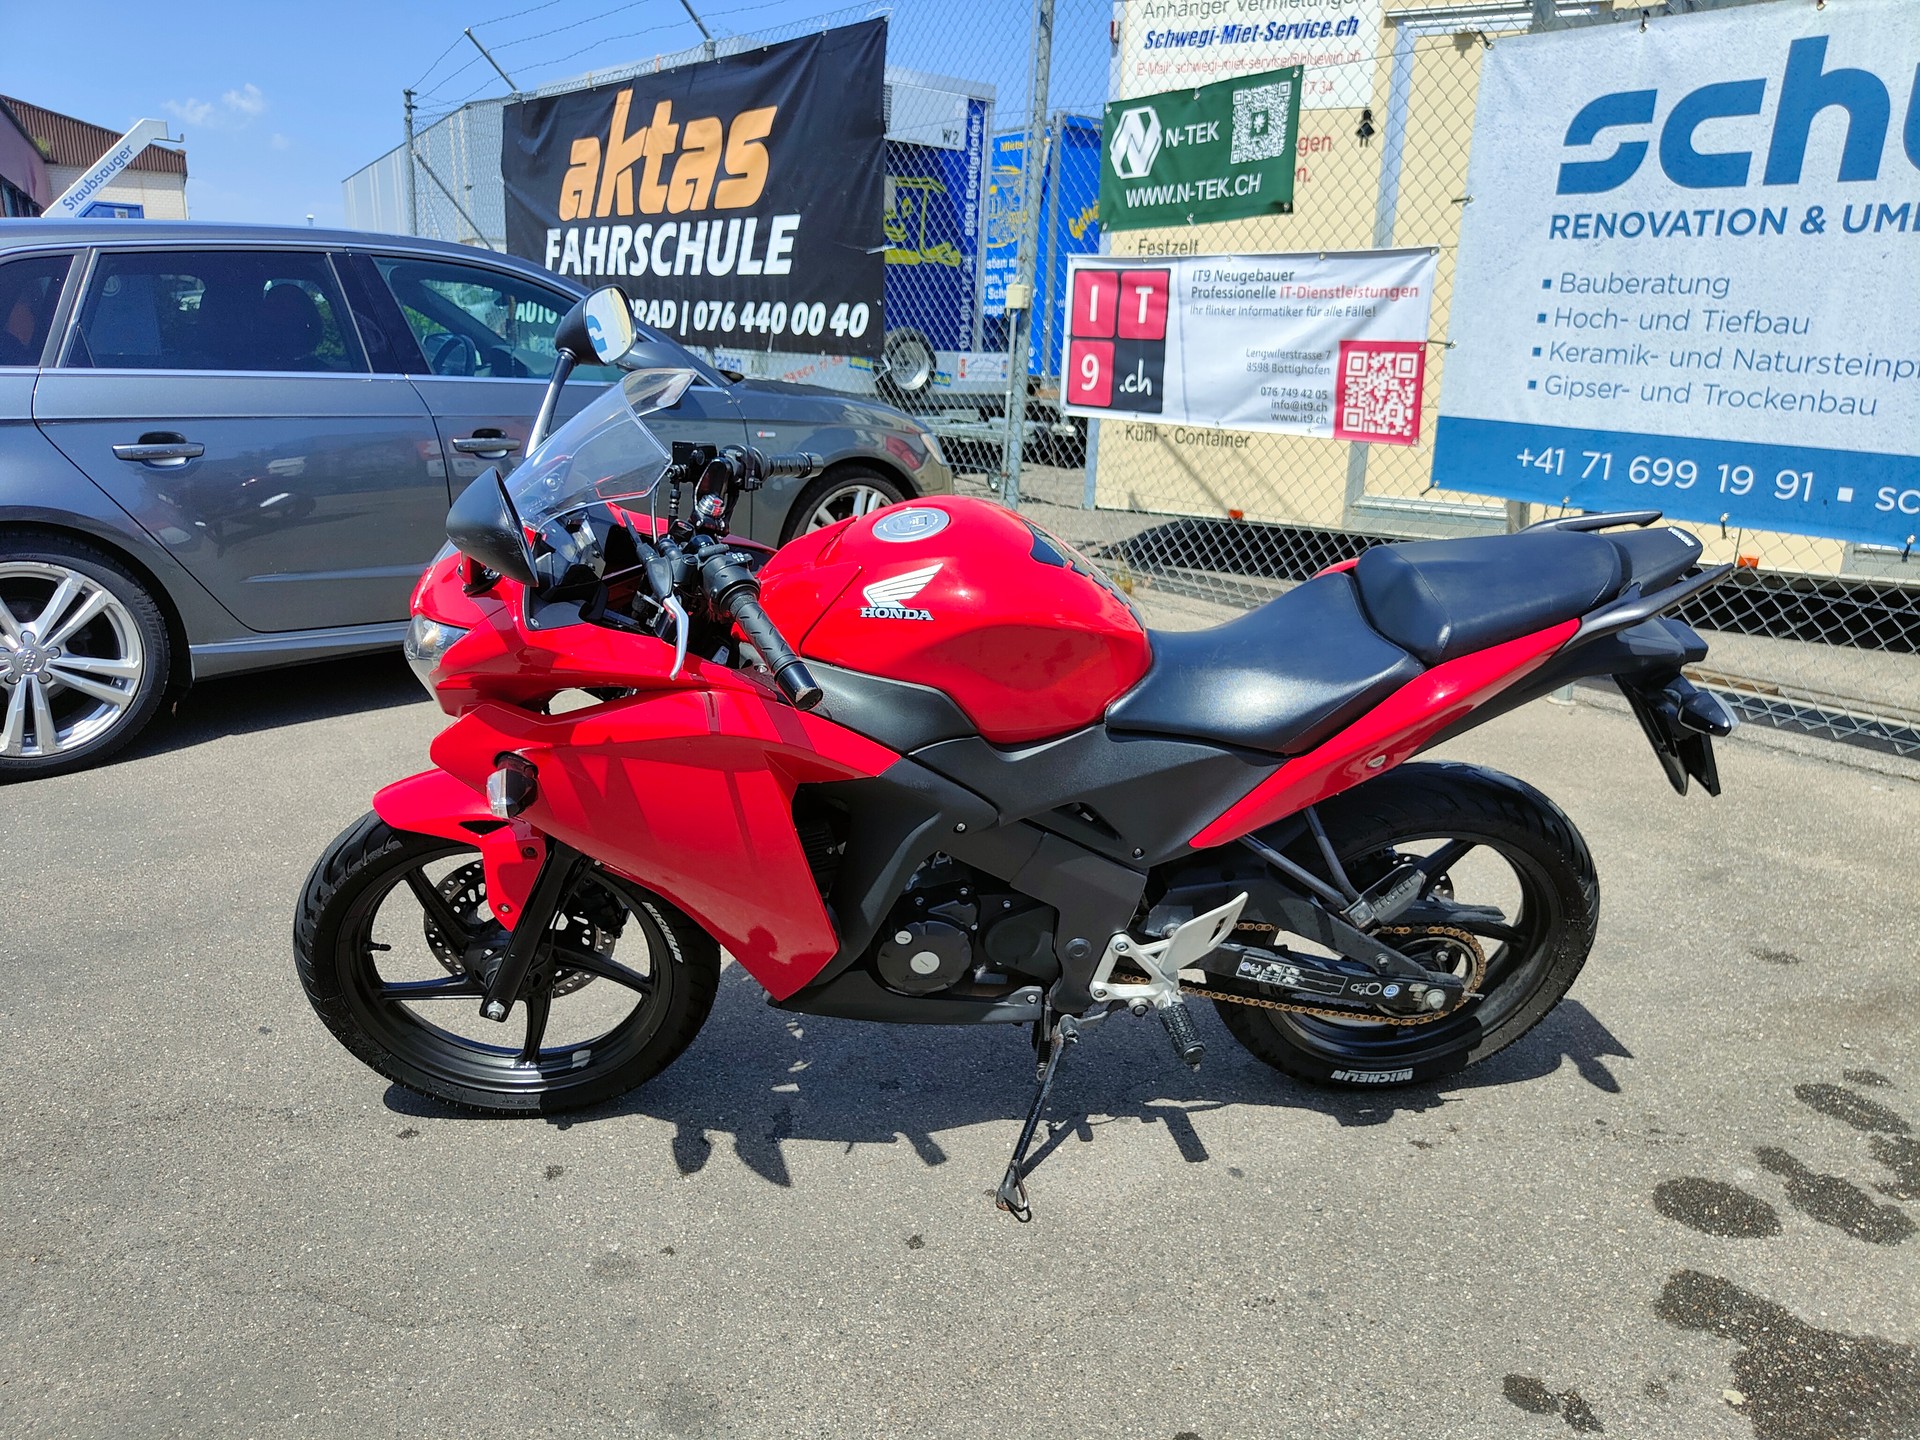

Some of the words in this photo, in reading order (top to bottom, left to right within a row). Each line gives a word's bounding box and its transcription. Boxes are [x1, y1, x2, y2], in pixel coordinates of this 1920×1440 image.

[1142, 0, 1230, 20] Anhänger
[1143, 15, 1360, 50] Schwegi-Miet-Service.ch
[1555, 35, 1920, 195] sch
[1165, 120, 1220, 148] N-TEK
[558, 88, 778, 222] aktas
[965, 114, 983, 200] Bottighofen
[62, 144, 133, 211] Staubsauger
[1125, 172, 1262, 208] WWW.N-TEK.CH
[1549, 207, 1788, 240] RENOVATION
[1799, 205, 1827, 235] &
[545, 214, 801, 276] FAHRSCHULE
[1137, 237, 1199, 256] Festzelt
[1192, 269, 1211, 283] IT9
[1214, 268, 1295, 284] Neugebauer
[1559, 272, 1731, 299] Bauberatung
[1191, 285, 1276, 299] Professionelle
[1279, 284, 1419, 302] IT-Dienstleistungen
[693, 300, 737, 332] 076
[739, 301, 787, 335] 440
[790, 301, 827, 337] 00
[829, 302, 870, 338] 40
[1190, 303, 1204, 316] Ihr
[1205, 304, 1237, 316] flinker
[1238, 304, 1303, 317] Informatiker
[1305, 304, 1322, 317] für
[1324, 304, 1342, 317] alle
[1345, 304, 1376, 318] Fälle!
[1554, 306, 1629, 331] Hoch-
[1638, 309, 1689, 333] und
[1702, 309, 1810, 336] Tiefbau
[1245, 347, 1322, 361] Lengwilerstrasse
[1325, 350, 1332, 359] 7
[1548, 341, 1659, 367] Keramik-
[1669, 344, 1721, 370] und
[1118, 358, 1153, 396] .ch
[1246, 362, 1269, 373] 8598
[1271, 363, 1330, 377] Bottighofen
[1260, 386, 1278, 397] 076
[1280, 387, 1298, 398] 749
[1300, 389, 1313, 399] 42
[1315, 389, 1328, 400] 05
[1271, 399, 1328, 413] info@it9.ch
[1544, 375, 1630, 402] Gipser-
[1640, 377, 1691, 404] und
[1703, 382, 1878, 417] Trockenbau
[1270, 413, 1327, 424] www.it9.ch
[1125, 424, 1158, 442] Kühl
[1174, 427, 1250, 449] Container
[1516, 447, 1565, 476] +41
[1581, 451, 1612, 481] 71
[1628, 455, 1698, 489] 699
[1716, 463, 1755, 496] 19
[1774, 469, 1815, 502] 91
[1875, 487, 1920, 515] sc
[859, 606, 935, 621] HONDA
[641, 901, 684, 963] MICHELIN
[1330, 1067, 1414, 1084] MICHELIN
